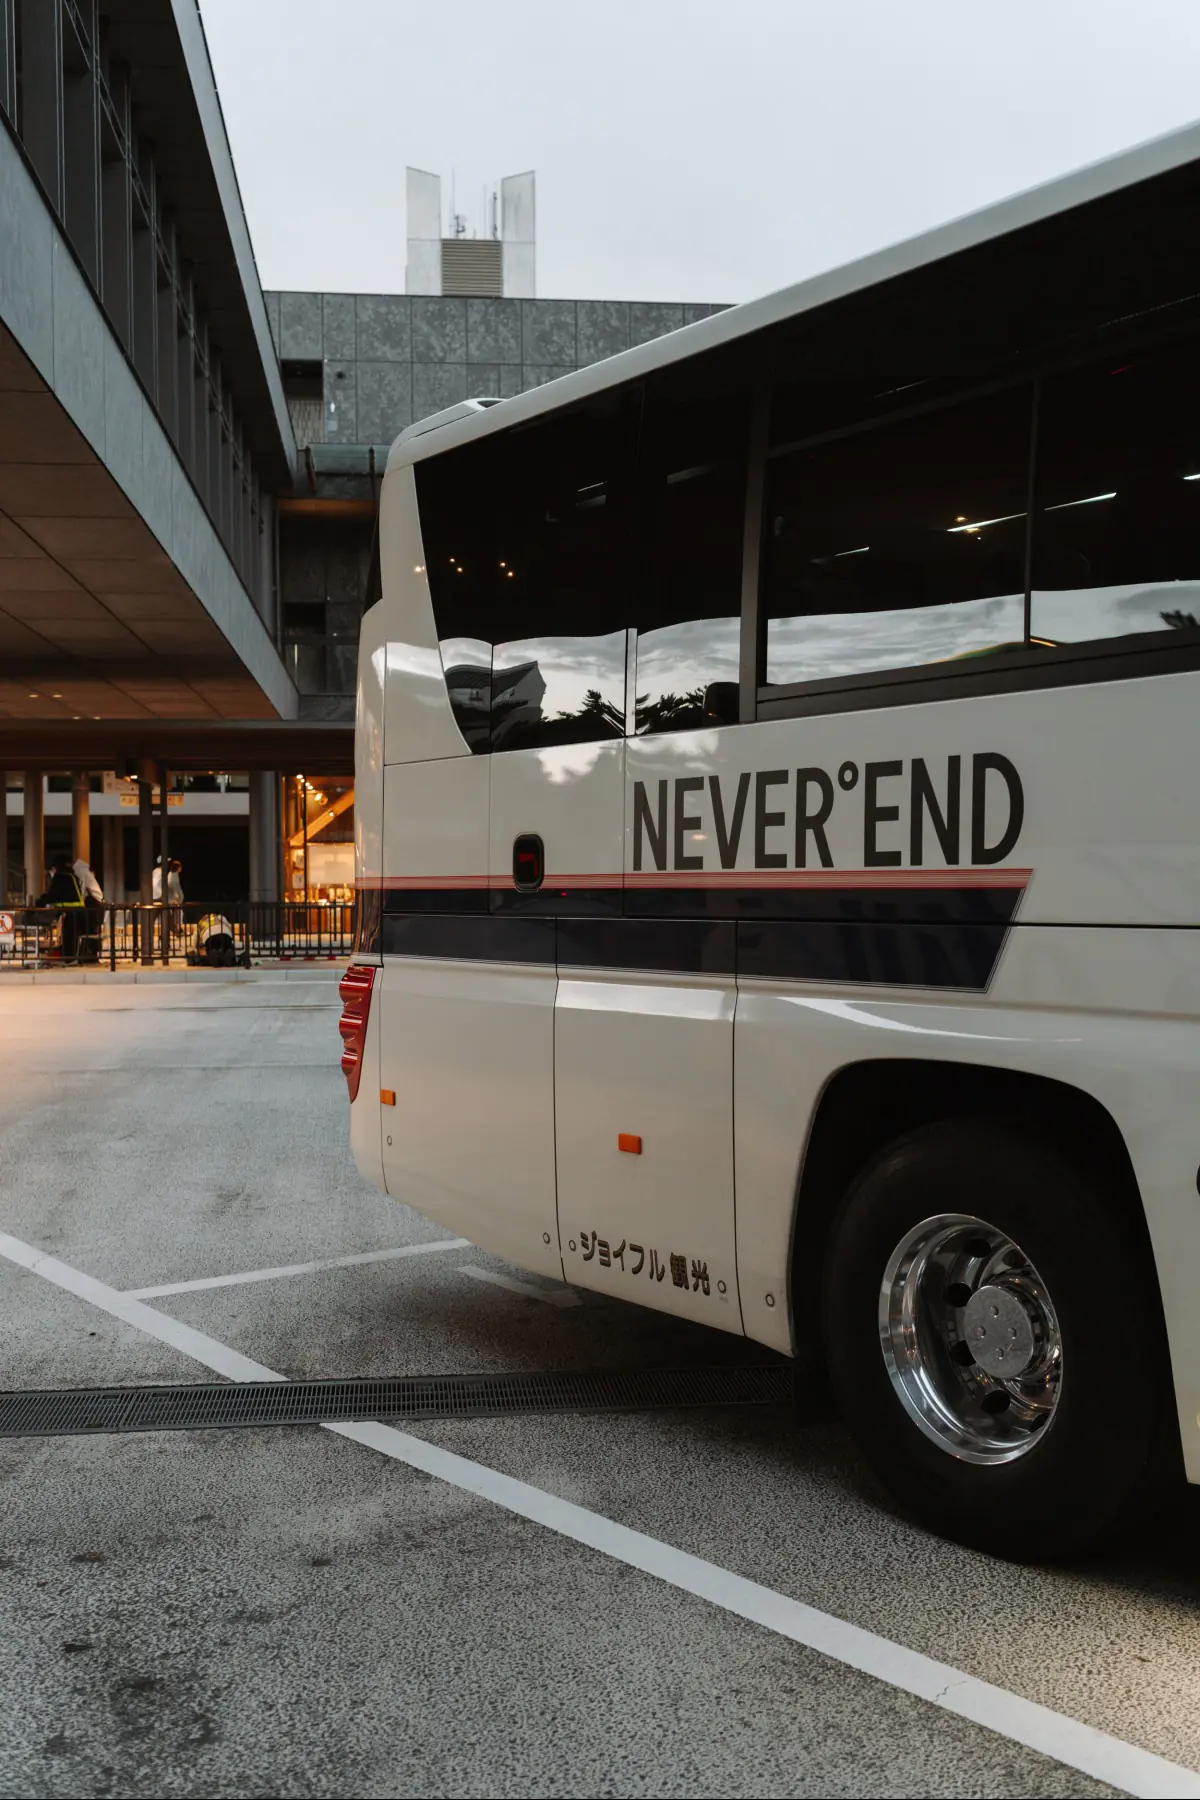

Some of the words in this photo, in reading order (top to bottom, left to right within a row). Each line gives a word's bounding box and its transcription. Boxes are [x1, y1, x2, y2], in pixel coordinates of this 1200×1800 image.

[580, 1230, 710, 1296] ジョイフル観光
